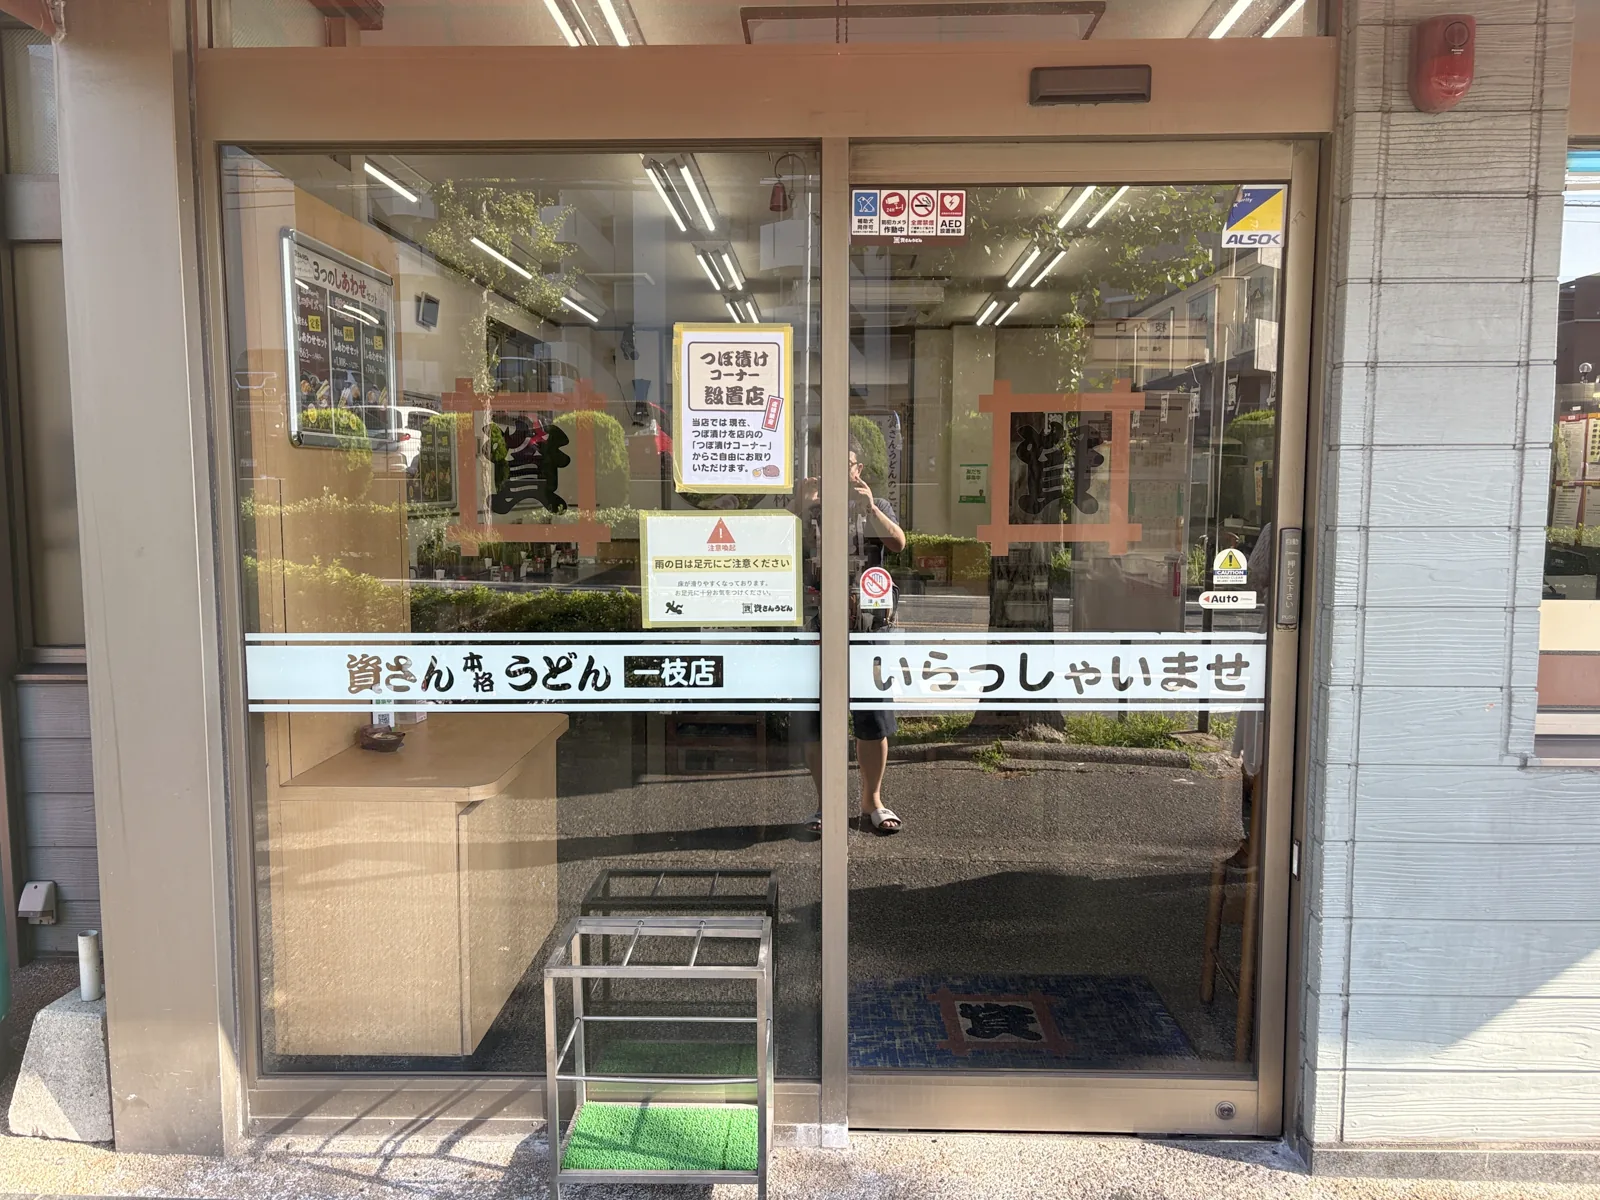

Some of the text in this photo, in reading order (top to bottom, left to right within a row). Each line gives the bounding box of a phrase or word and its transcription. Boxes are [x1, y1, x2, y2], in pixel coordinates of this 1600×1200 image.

[940, 220, 962, 228] AED
[1226, 234, 1280, 245] ALSOK
[700, 350, 769, 368] つぼ漬け
[710, 369, 760, 381] コーナー
[704, 386, 764, 406] 設置店
[692, 430, 763, 438] つぼ漬けを店内の
[692, 441, 772, 450] 「つぼ漬けコーナー」
[692, 452, 771, 462] からご自由にお取り
[692, 464, 749, 472] いただけます。
[654, 558, 790, 570] 雨の日は足元にご注意ください
[1286, 560, 1296, 608] 押して下さい
[1211, 595, 1238, 603] Auto
[754, 604, 793, 612] 資さんうどん
[346, 651, 715, 695] 資さん 本格 うどん 一枝店
[873, 651, 1250, 694] いらっしゃいませ
